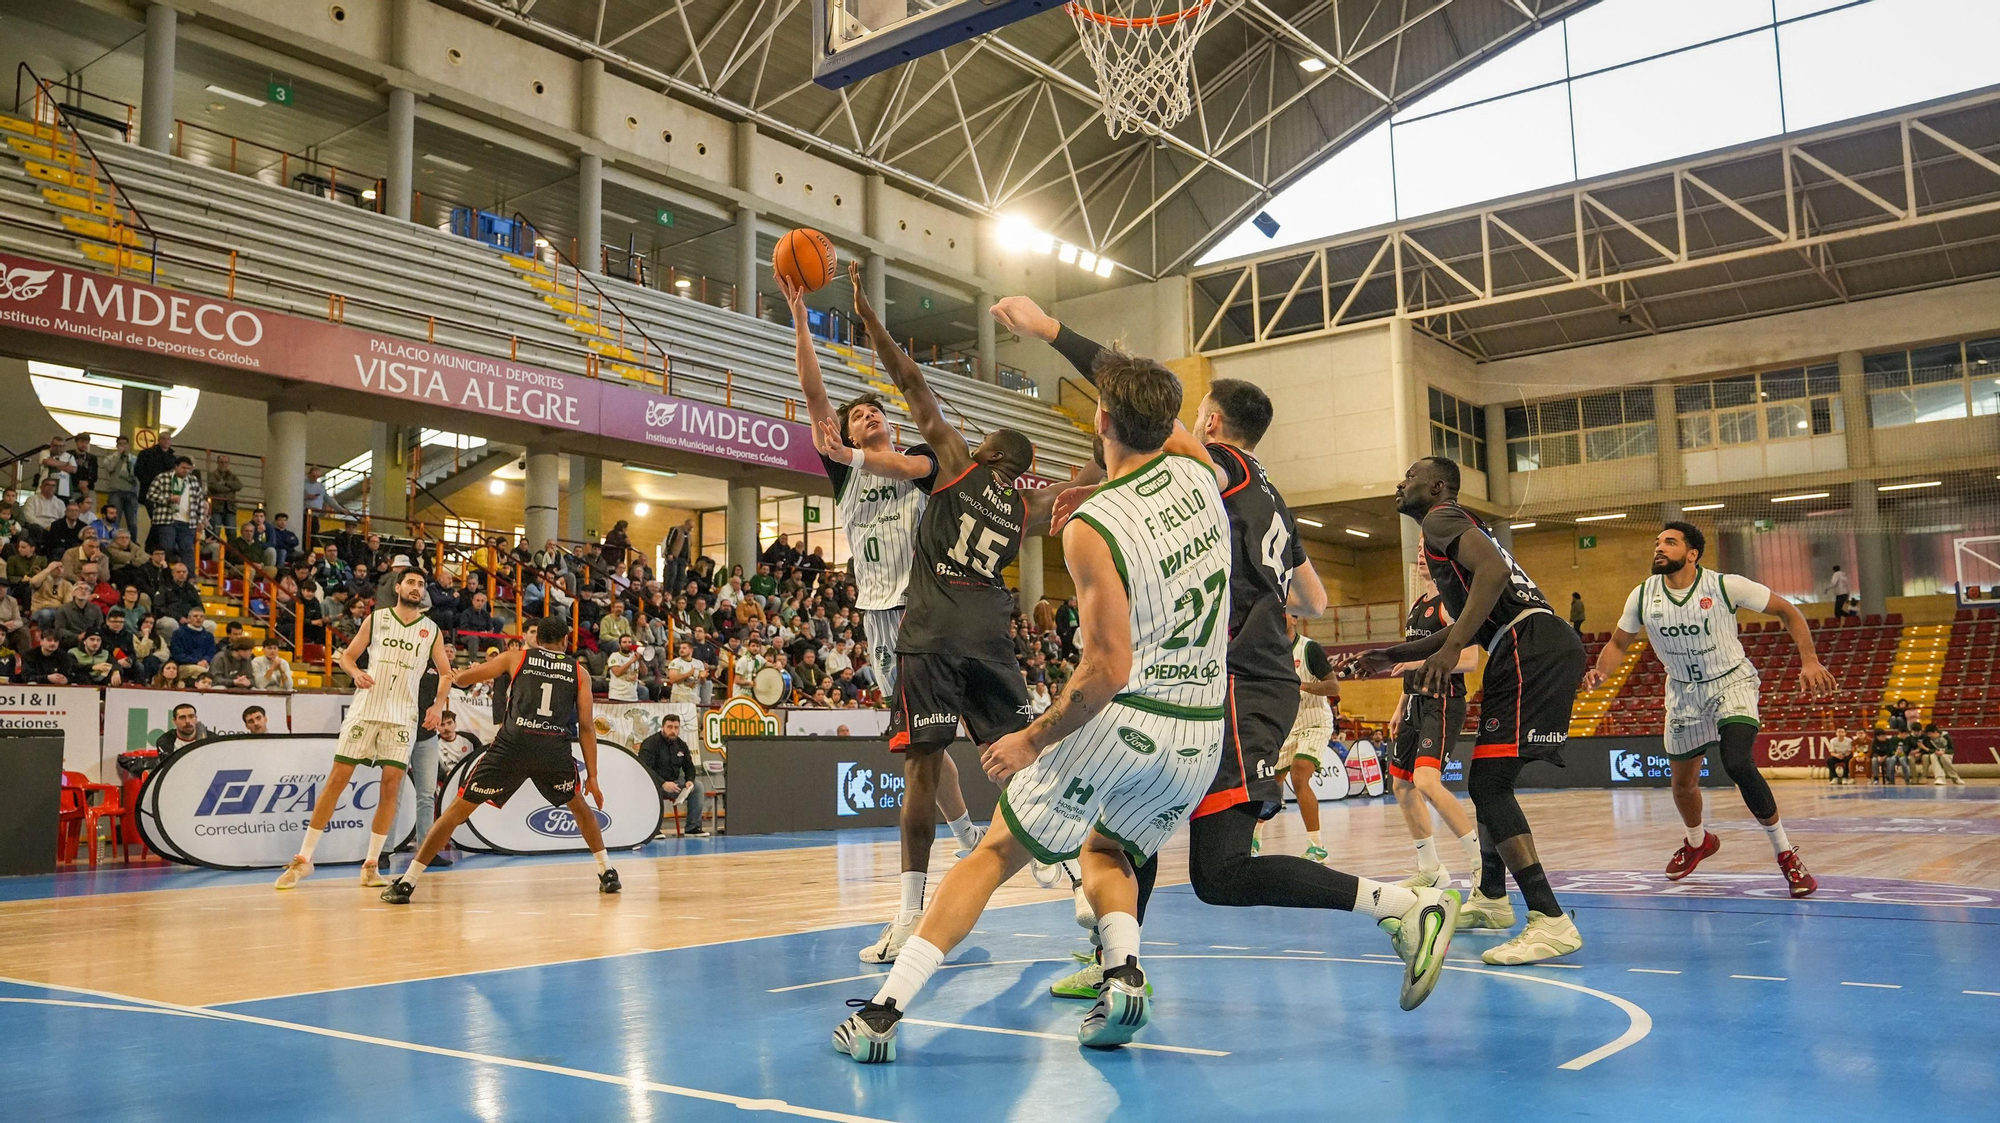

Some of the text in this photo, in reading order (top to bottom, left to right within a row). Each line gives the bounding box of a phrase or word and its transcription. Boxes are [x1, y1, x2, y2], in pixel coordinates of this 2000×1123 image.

[276, 87, 286, 101] 3
[660, 212, 668, 223] 4
[60, 273, 263, 347] IMDECO
[54, 318, 122, 342] Municipal
[126, 333, 143, 346] de
[147, 336, 205, 357] Deportes
[208, 348, 260, 368] Córdoba
[370, 339, 564, 391] PALACIO MUNICIPAL DEPORTES
[353, 354, 581, 426] VISTA ALEGRE
[681, 404, 789, 451] IMDECO
[645, 431, 788, 467] Instituto Municipal de Deportes Córdoba
[808, 509, 816, 521] D
[947, 512, 1010, 579] 15
[1583, 538, 1591, 547] K
[1160, 567, 1226, 650] 27
[1660, 623, 1700, 637] coto
[382, 637, 413, 652] coto
[1686, 664, 1703, 682] 15
[390, 674, 397, 692] 7
[30, 693, 42, 706] &
[536, 682, 553, 717] 1
[1123, 729, 1150, 753] Ford
[1176, 757, 1199, 765] TYSA
[280, 774, 326, 784] GRUPO
[1648, 768, 1661, 777] de
[879, 794, 895, 808] de
[1057, 799, 1086, 816] Hospital
[194, 819, 364, 836] Correduria de Sguros
[544, 806, 579, 832] For
